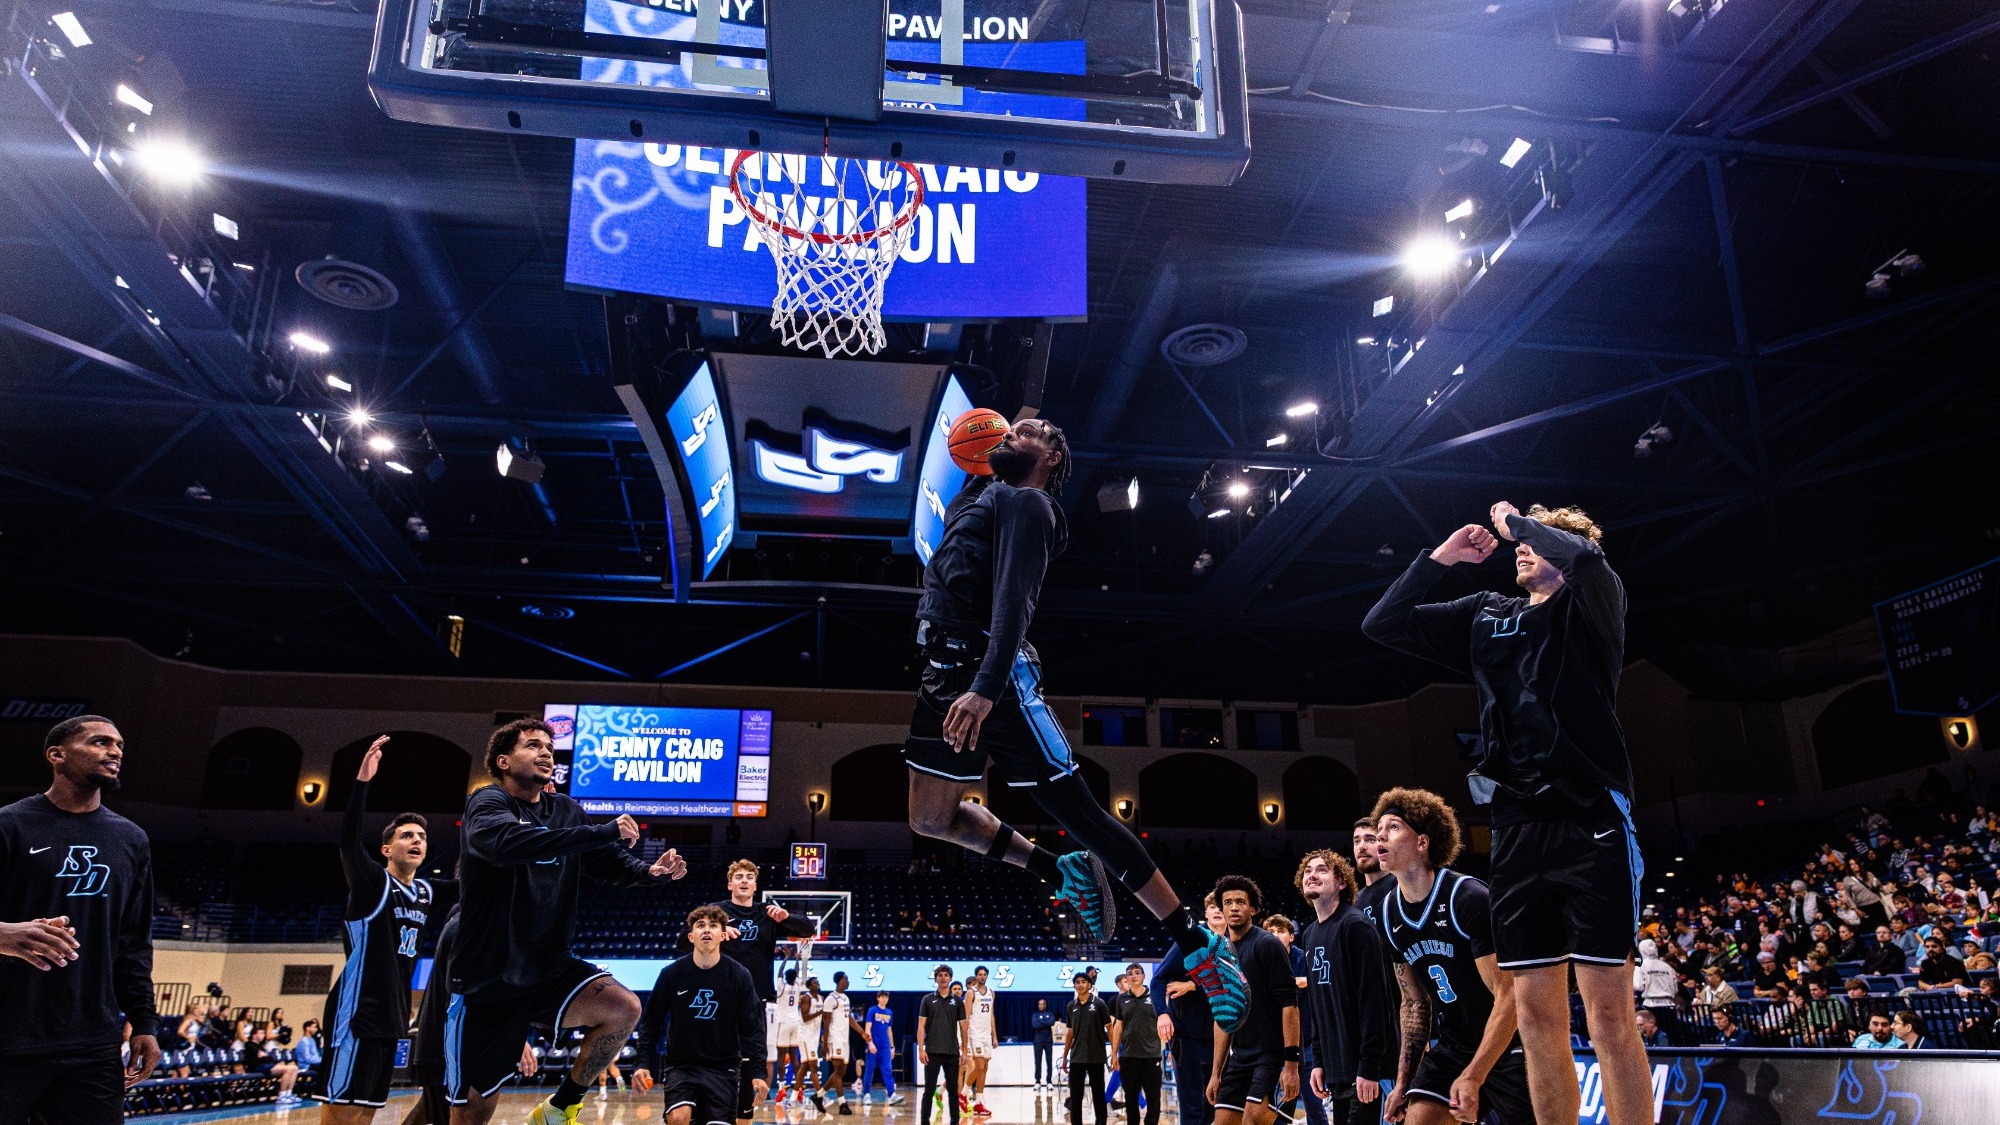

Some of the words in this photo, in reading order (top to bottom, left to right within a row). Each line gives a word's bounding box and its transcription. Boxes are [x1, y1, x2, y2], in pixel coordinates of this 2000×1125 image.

[708, 185, 976, 264] PAVILION
[967, 417, 1004, 434] ELITE
[1, 699, 86, 719] DIEGO
[631, 727, 677, 736] WELCOME
[678, 728, 691, 736] TO
[594, 736, 662, 759] JENNY
[665, 738, 724, 761] CRAIG
[613, 759, 702, 783] PAVILION
[740, 765, 767, 774] Baker
[583, 802, 614, 812] Health
[616, 803, 623, 812] is
[624, 803, 679, 815] Reimagining
[795, 846, 817, 858] 31.4
[797, 857, 820, 875] 30
[1403, 942, 1424, 966] SAN
[1420, 939, 1455, 959] DIEGO
[1427, 964, 1458, 1004] 3
[788, 995, 796, 1007] 8
[980, 1003, 990, 1013] 23
